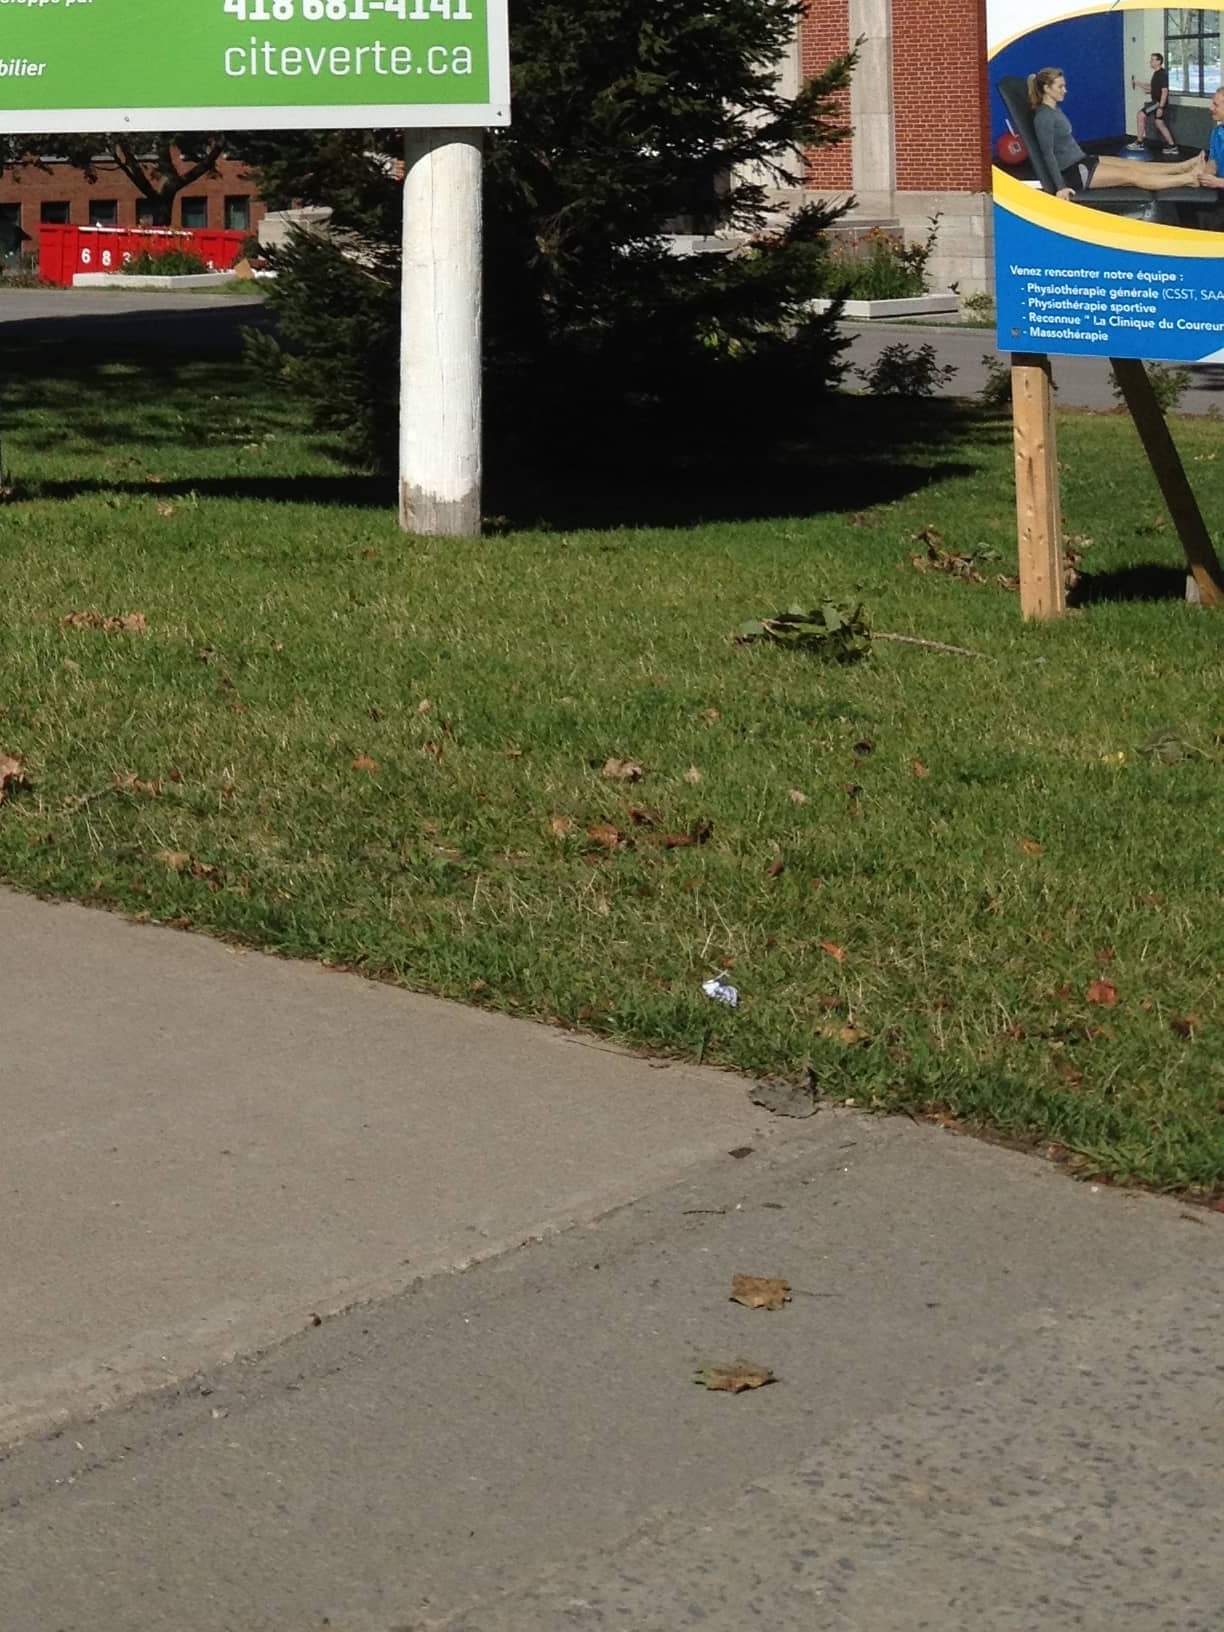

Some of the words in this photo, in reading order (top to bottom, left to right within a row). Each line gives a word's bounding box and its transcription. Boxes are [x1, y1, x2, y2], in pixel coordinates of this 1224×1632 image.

[224, 36, 473, 76] citeverte.ca
[1010, 265, 1042, 276] Venez
[1044, 268, 1100, 279] rencontrer
[1103, 270, 1134, 280] notre
[1137, 270, 1177, 283] équipe
[1027, 282, 1106, 298] Physiothérapie
[1109, 287, 1159, 299] générale
[1162, 287, 1198, 301] (CSST,
[1028, 297, 1108, 312] Physiothérapie
[1110, 302, 1157, 314] sportive
[1029, 312, 1081, 325] Reconnue
[1093, 315, 1107, 326] La
[1109, 316, 1155, 330] Clinique
[1158, 318, 1174, 329] du
[1029, 327, 1109, 342] Massothérapie
